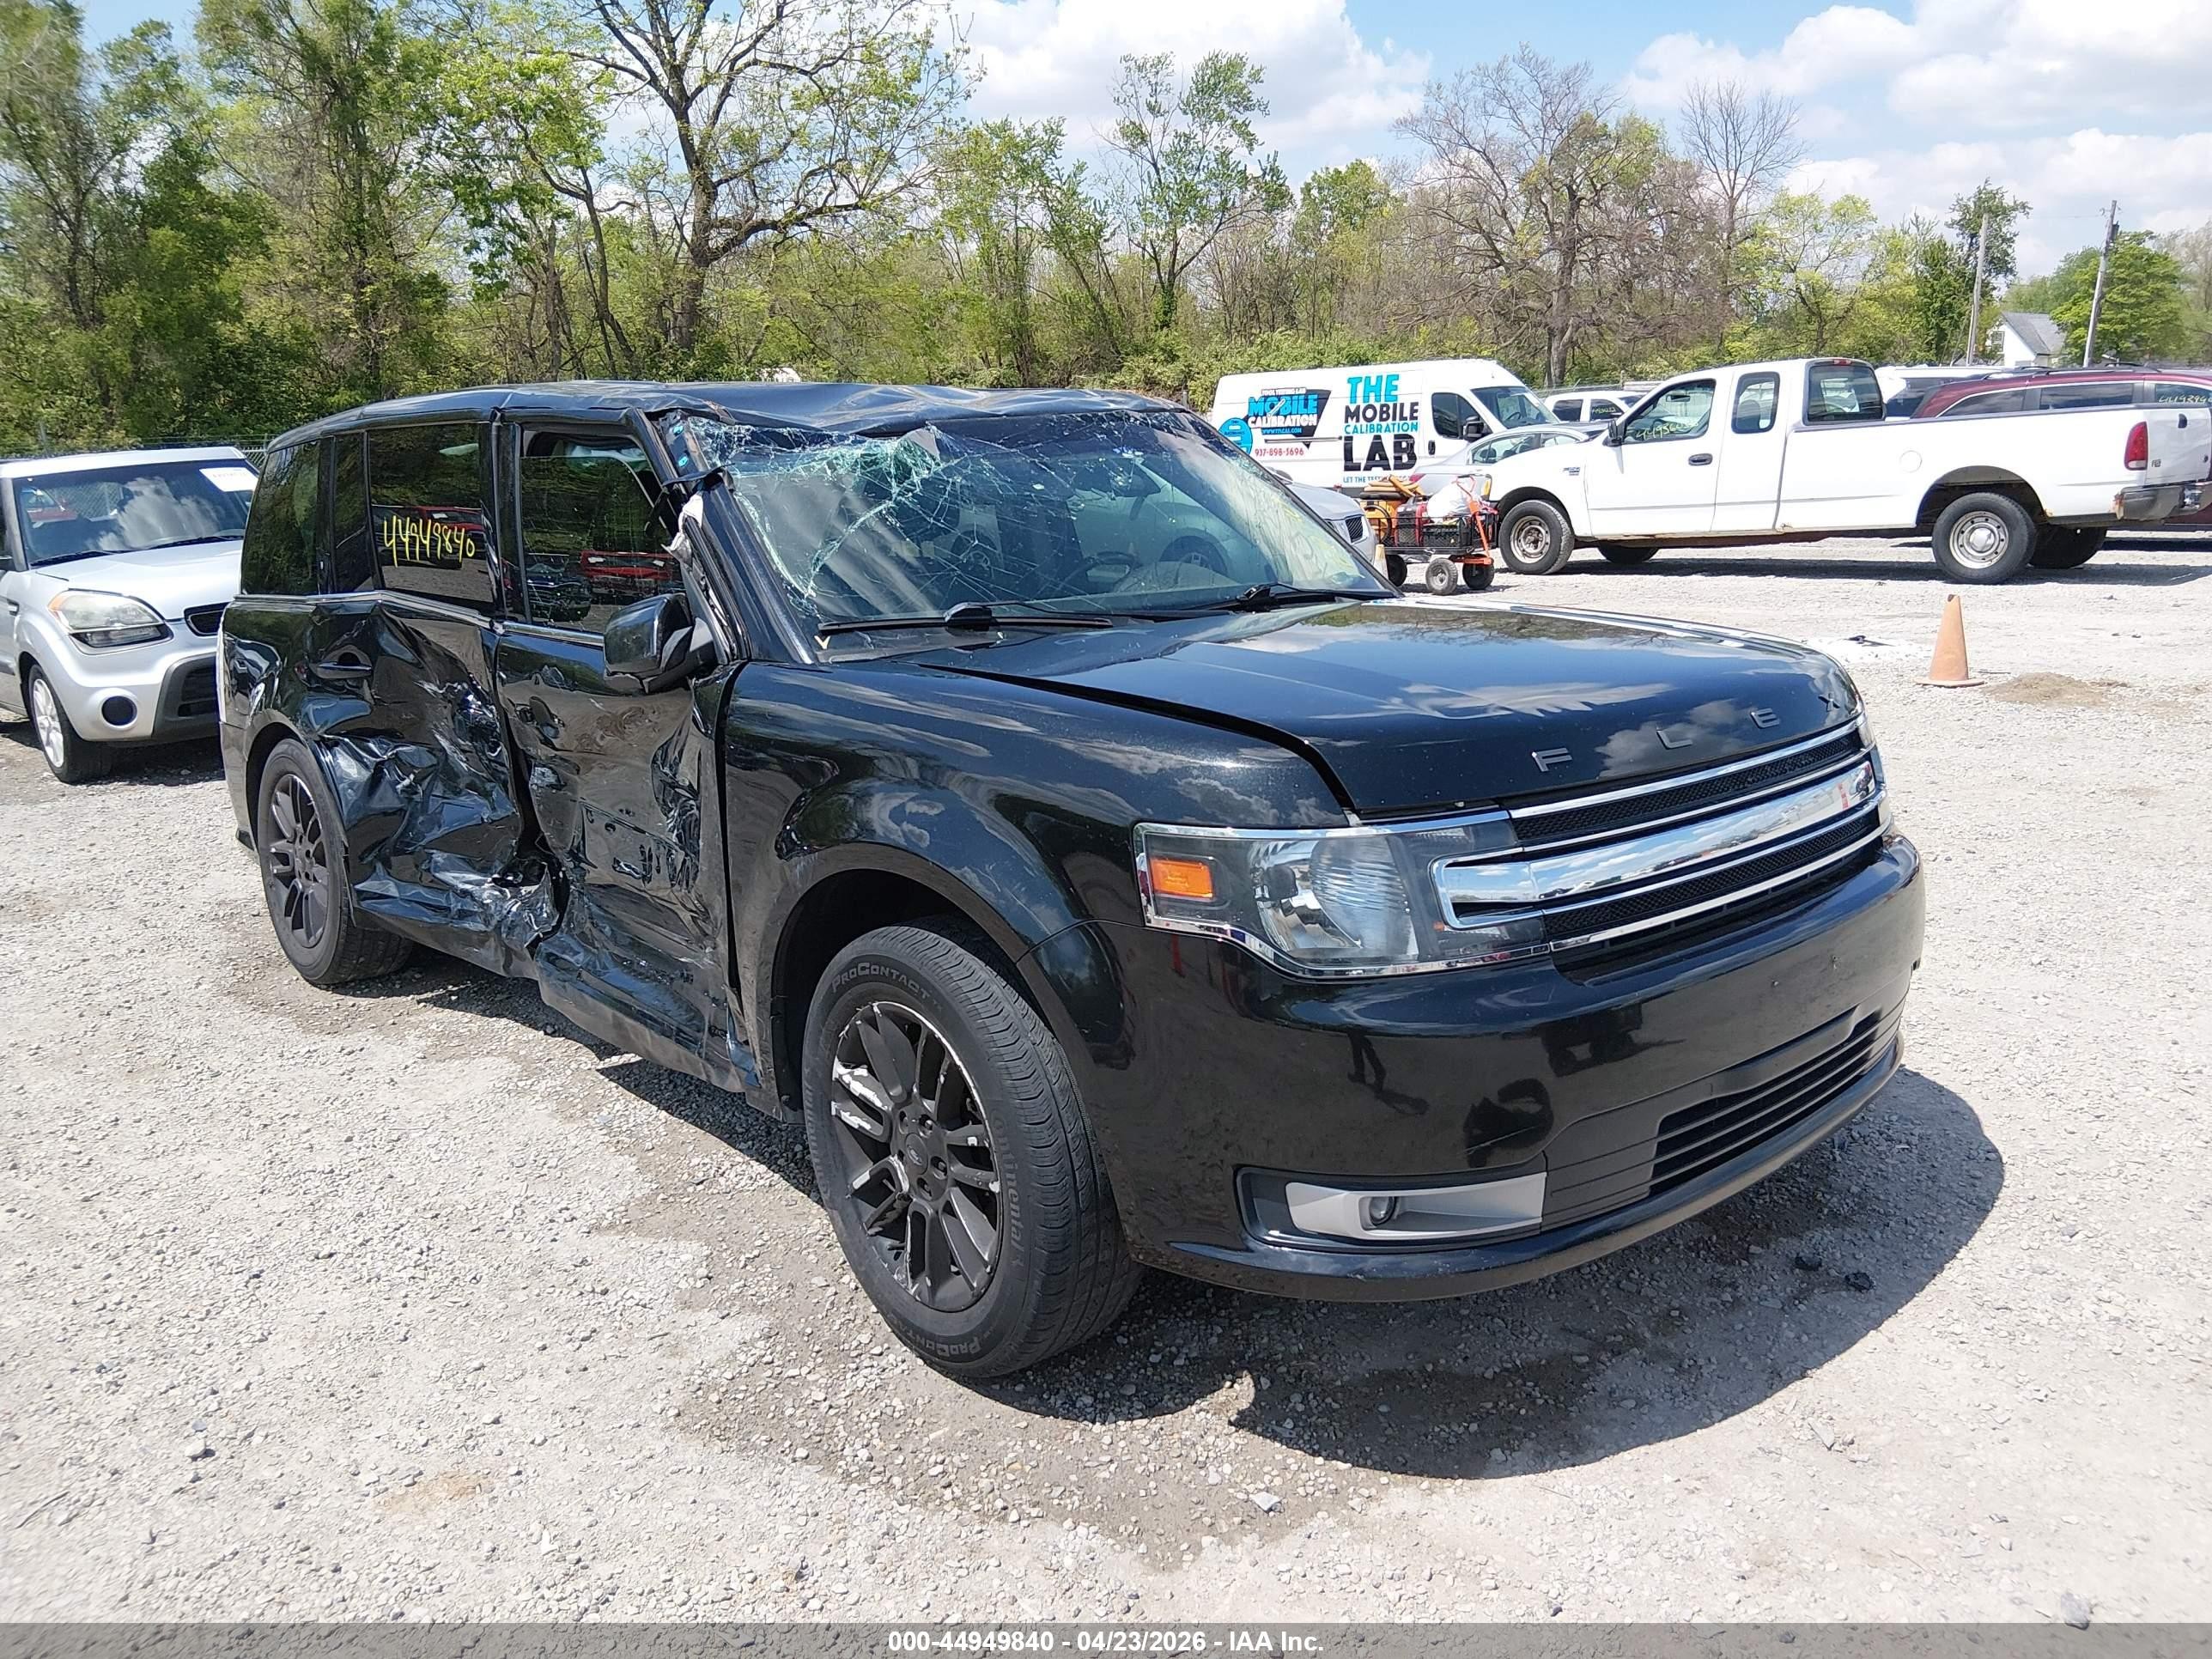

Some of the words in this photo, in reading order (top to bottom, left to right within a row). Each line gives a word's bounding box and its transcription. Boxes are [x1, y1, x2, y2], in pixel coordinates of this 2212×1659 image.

[1347, 374, 1399, 404] THE
[1249, 394, 1318, 416] MOBILE
[1344, 402, 1419, 423] MOBILE
[1248, 414, 1317, 428] CALIBRATION
[1344, 422, 1419, 434] CALIBRATION
[1344, 434, 1417, 471] LAB
[384, 515, 475, 568] 44949840
